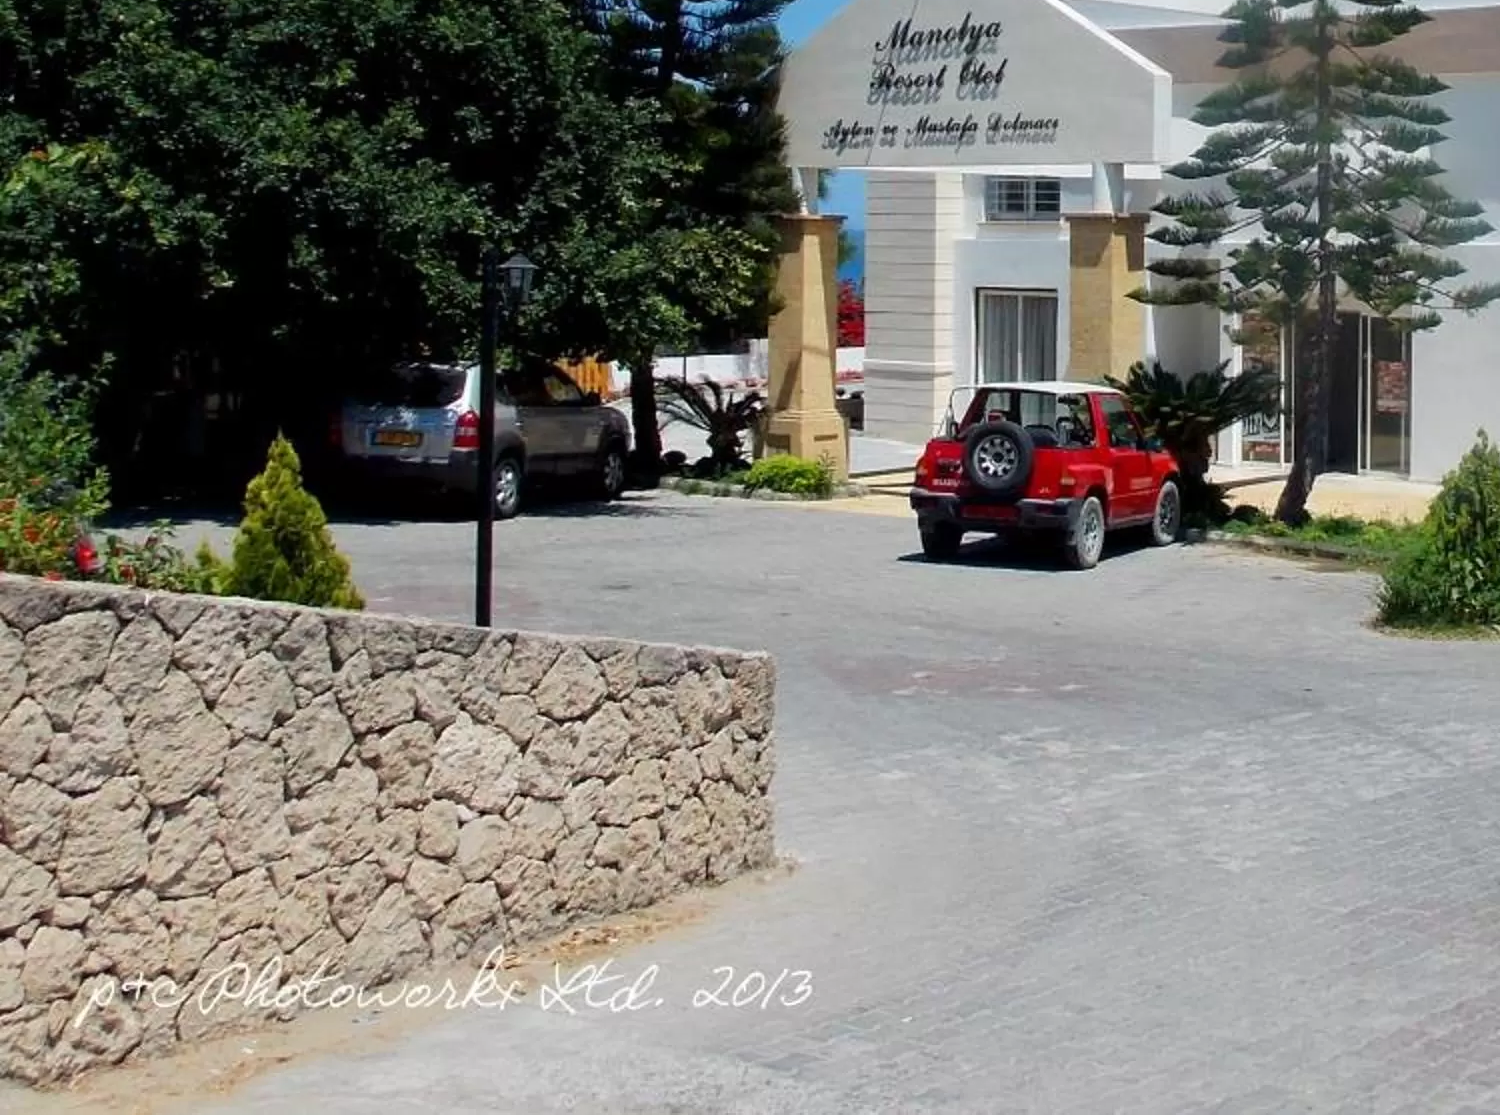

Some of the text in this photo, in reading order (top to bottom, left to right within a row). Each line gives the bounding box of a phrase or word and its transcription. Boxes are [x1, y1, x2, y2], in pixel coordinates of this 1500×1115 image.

[875, 11, 1003, 54] Manolya
[869, 56, 1008, 90] Resort Otel
[882, 123, 898, 136] ve
[906, 113, 979, 143] Mustafa
